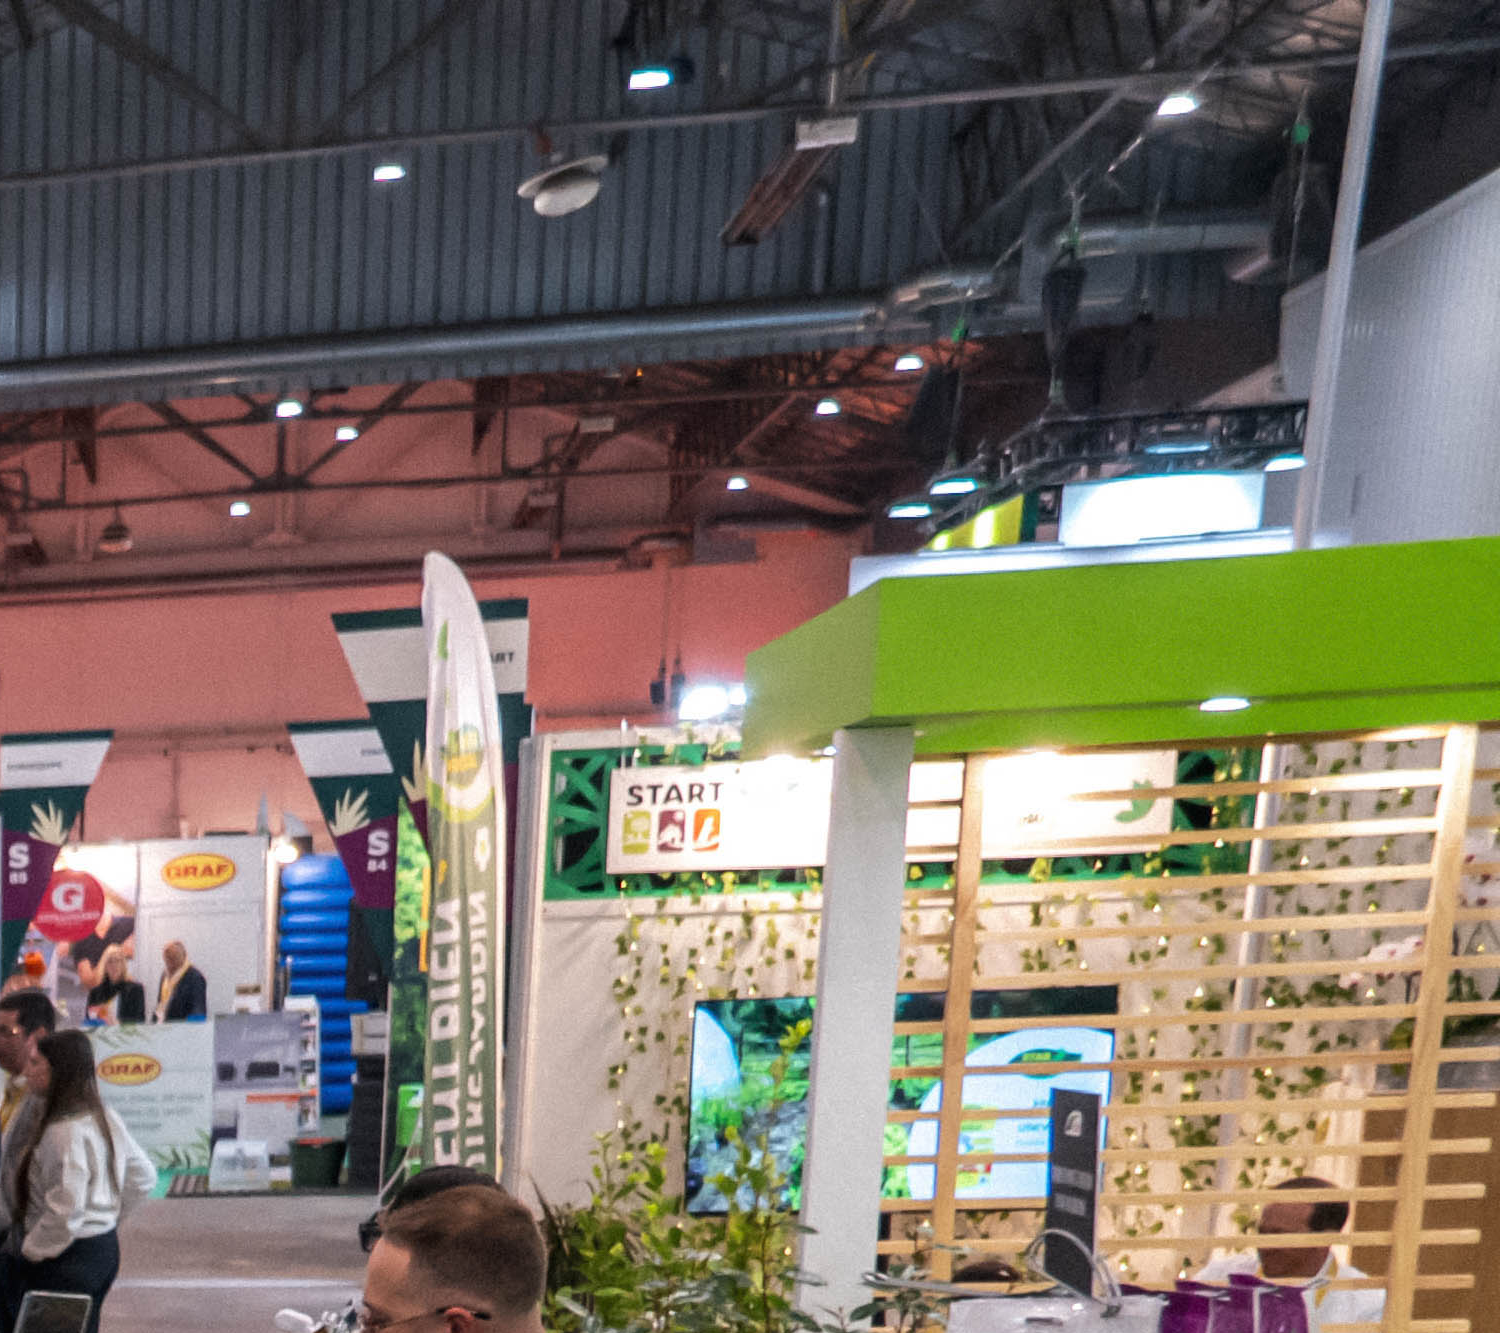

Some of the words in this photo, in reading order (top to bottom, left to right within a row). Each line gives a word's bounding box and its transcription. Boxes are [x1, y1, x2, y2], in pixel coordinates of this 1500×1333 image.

[627, 783, 723, 806] START
[368, 829, 390, 856] S
[8, 843, 29, 869] S
[167, 863, 229, 878] GRAF
[52, 882, 84, 912] G
